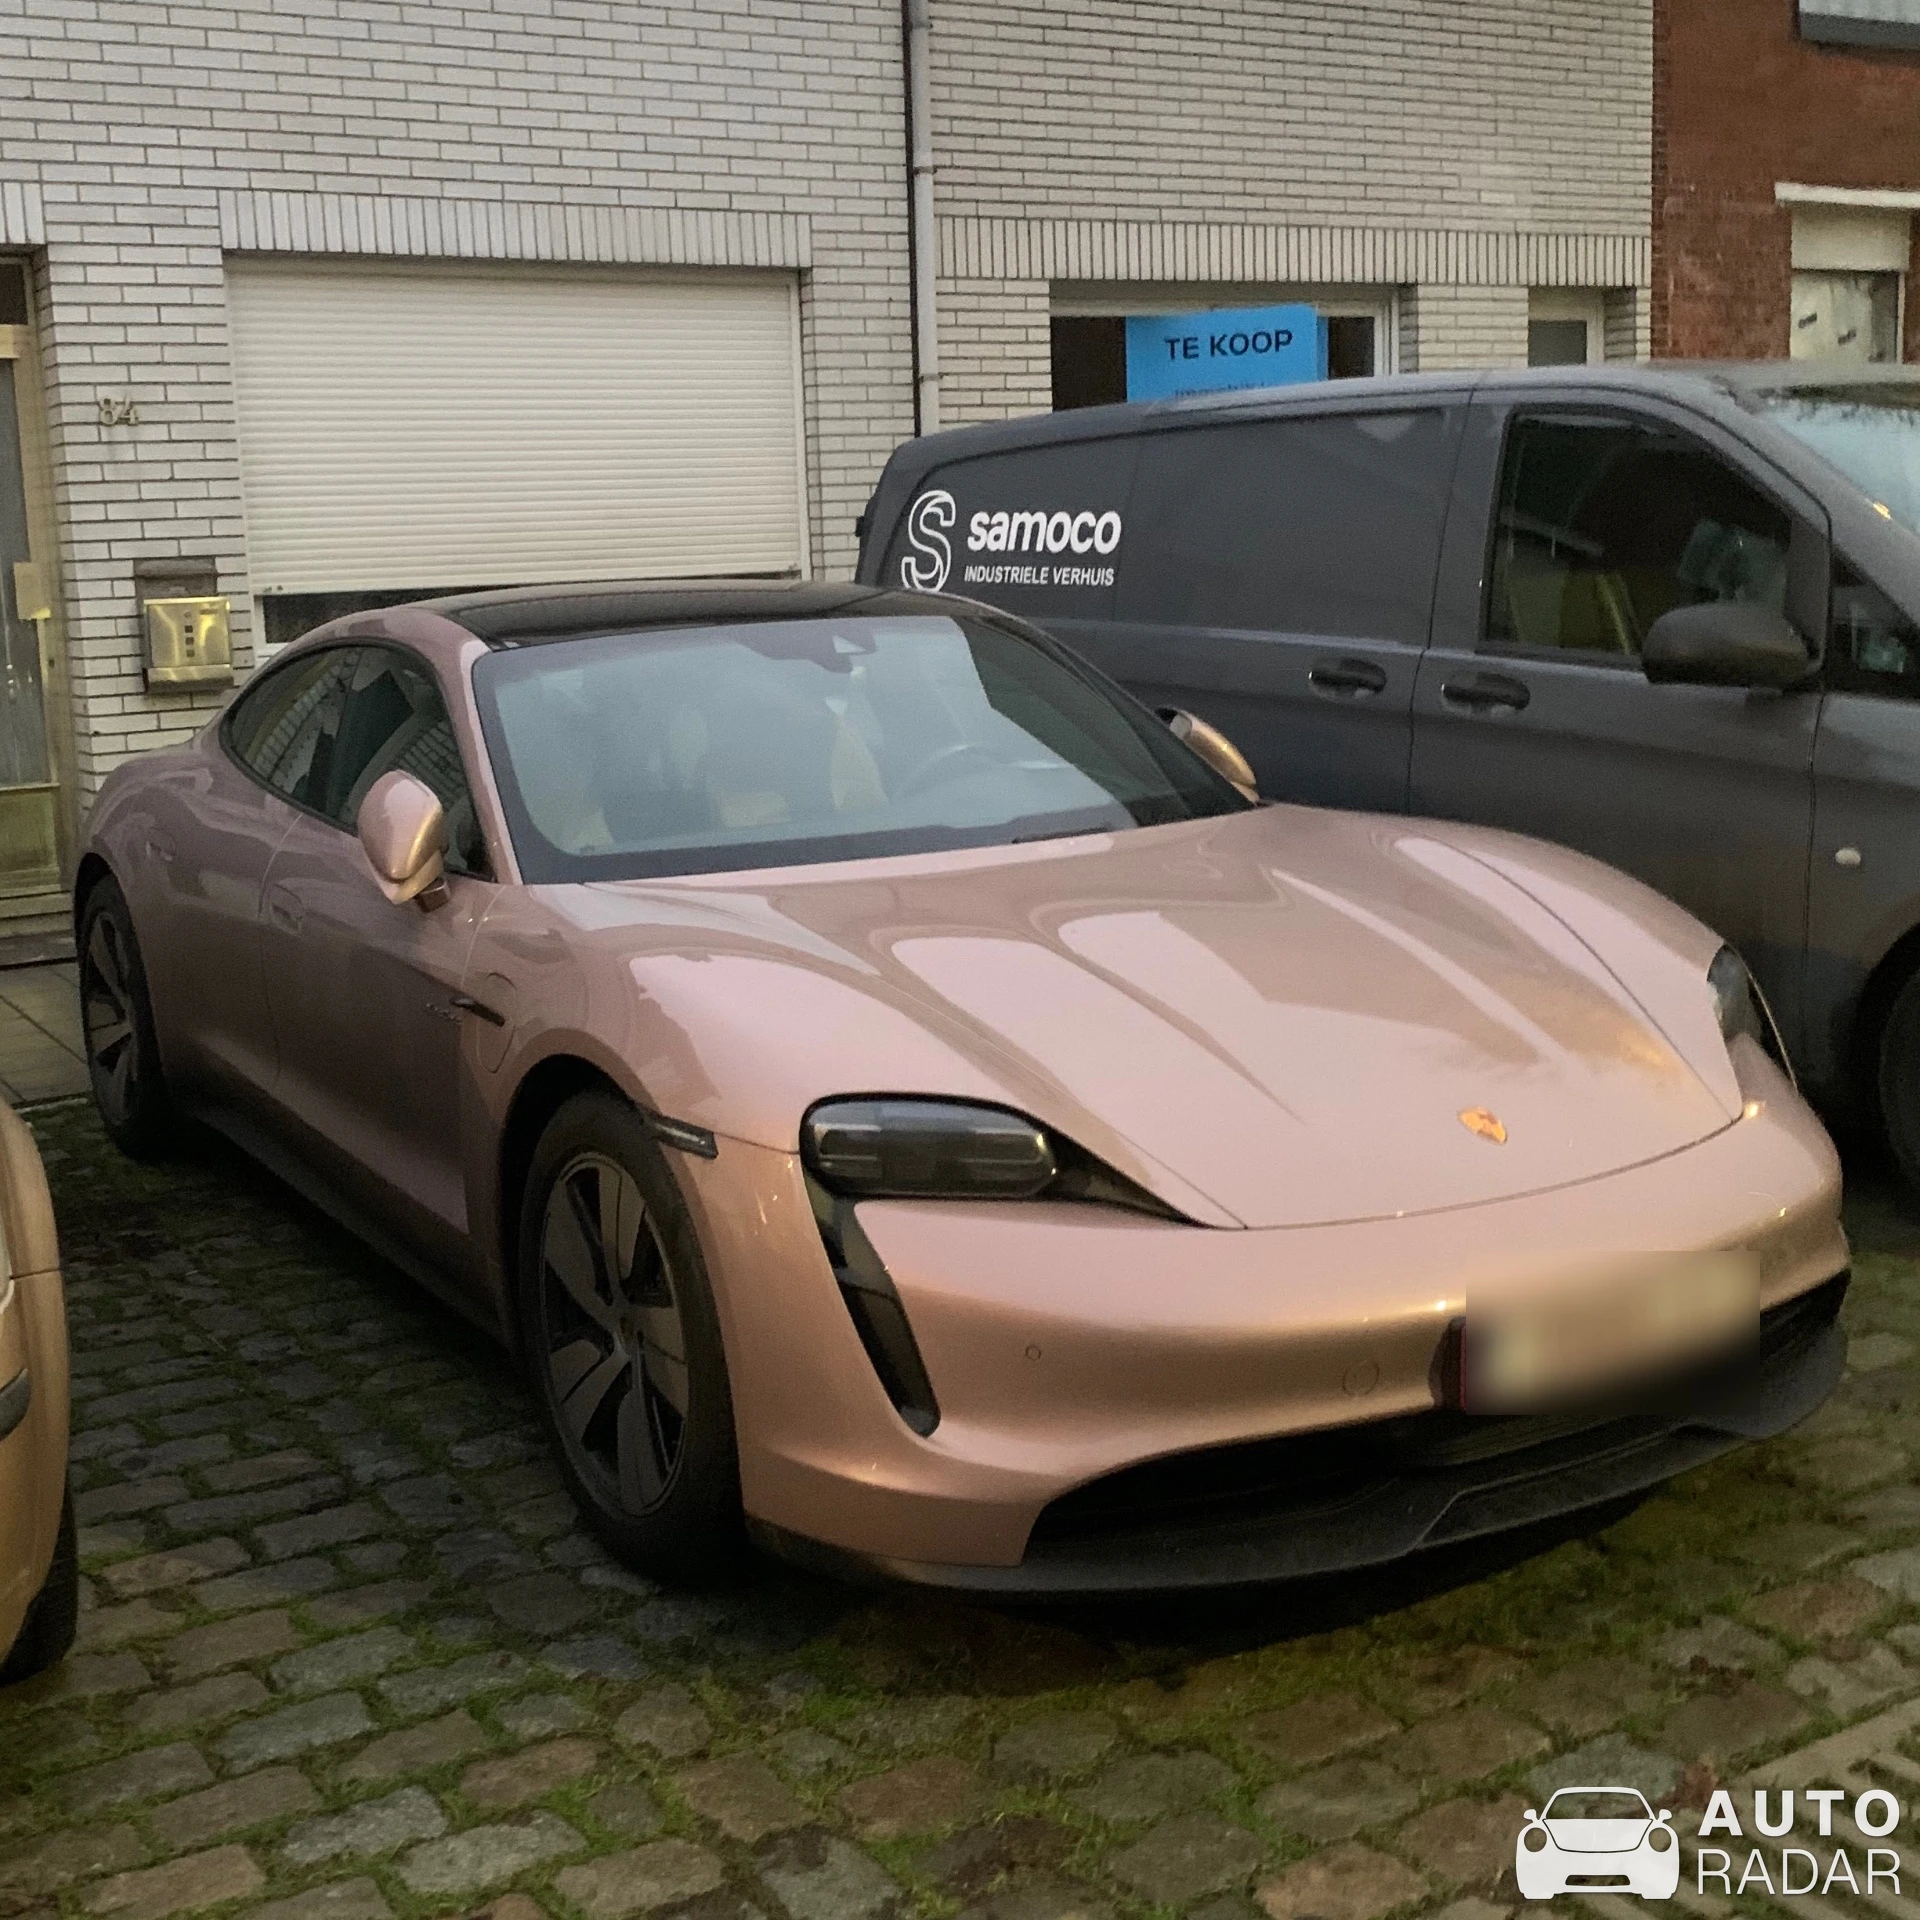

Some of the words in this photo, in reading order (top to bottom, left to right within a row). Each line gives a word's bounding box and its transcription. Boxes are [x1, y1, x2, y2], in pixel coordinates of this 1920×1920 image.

[1165, 337, 1199, 360] TE
[1210, 329, 1293, 358] KOOP
[99, 393, 138, 426] 84
[967, 511, 1122, 554] samoco
[964, 565, 1048, 585] INDUSTRIELE
[1053, 567, 1115, 586] VERHUIS
